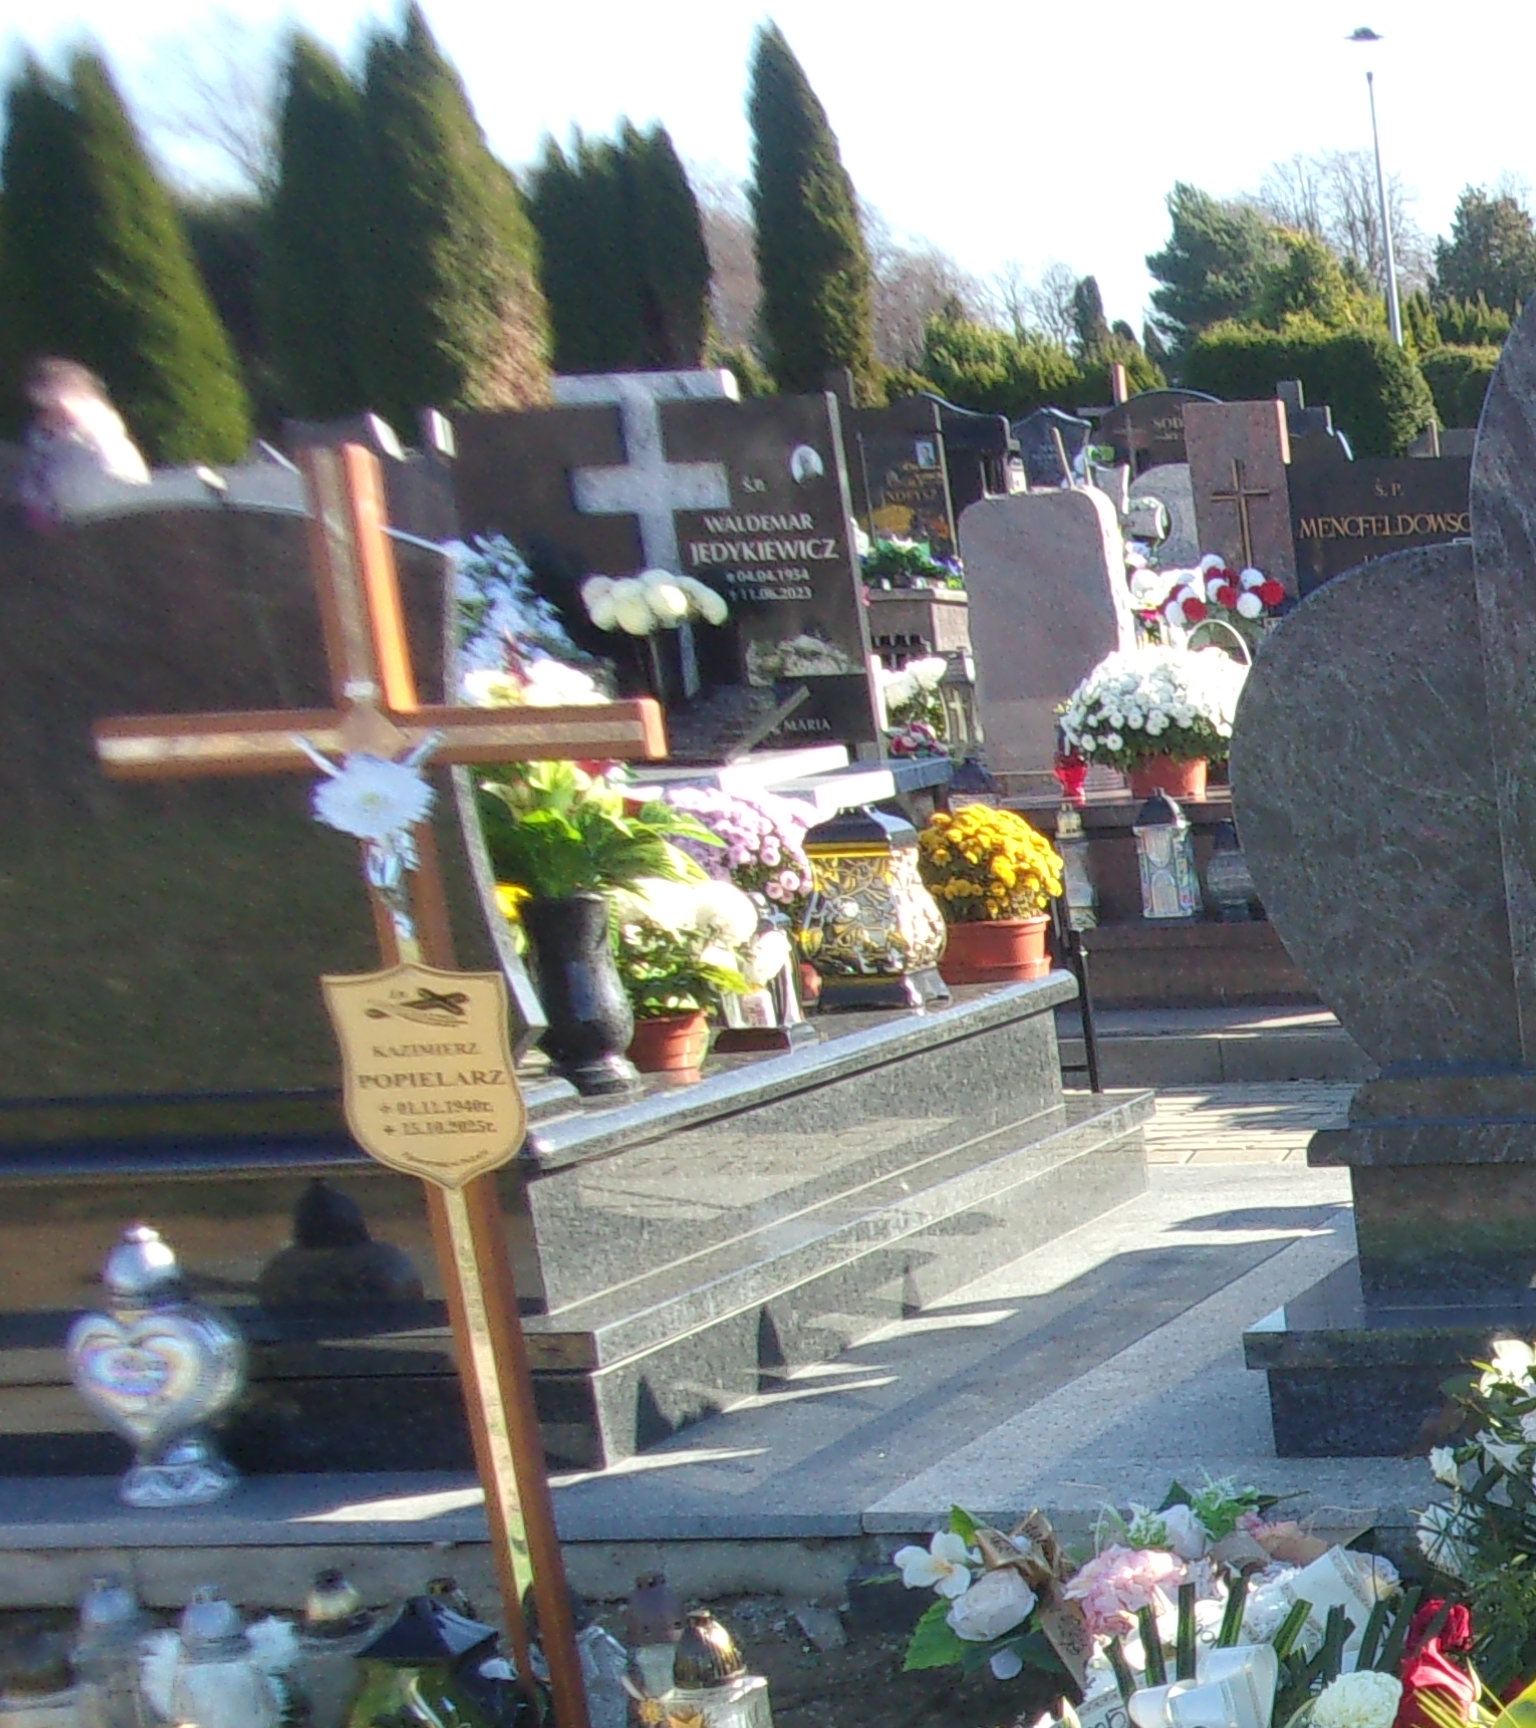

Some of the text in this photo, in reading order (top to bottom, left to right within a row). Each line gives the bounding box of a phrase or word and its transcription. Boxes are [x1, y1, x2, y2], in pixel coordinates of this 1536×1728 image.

[703, 512, 814, 534] WALDEMAR
[1300, 512, 1471, 539] MENCFELDOWSC
[783, 716, 831, 734] MARIA
[372, 1042, 480, 1058] KAZIMIERZ
[358, 1070, 506, 1090] POPIELARZ
